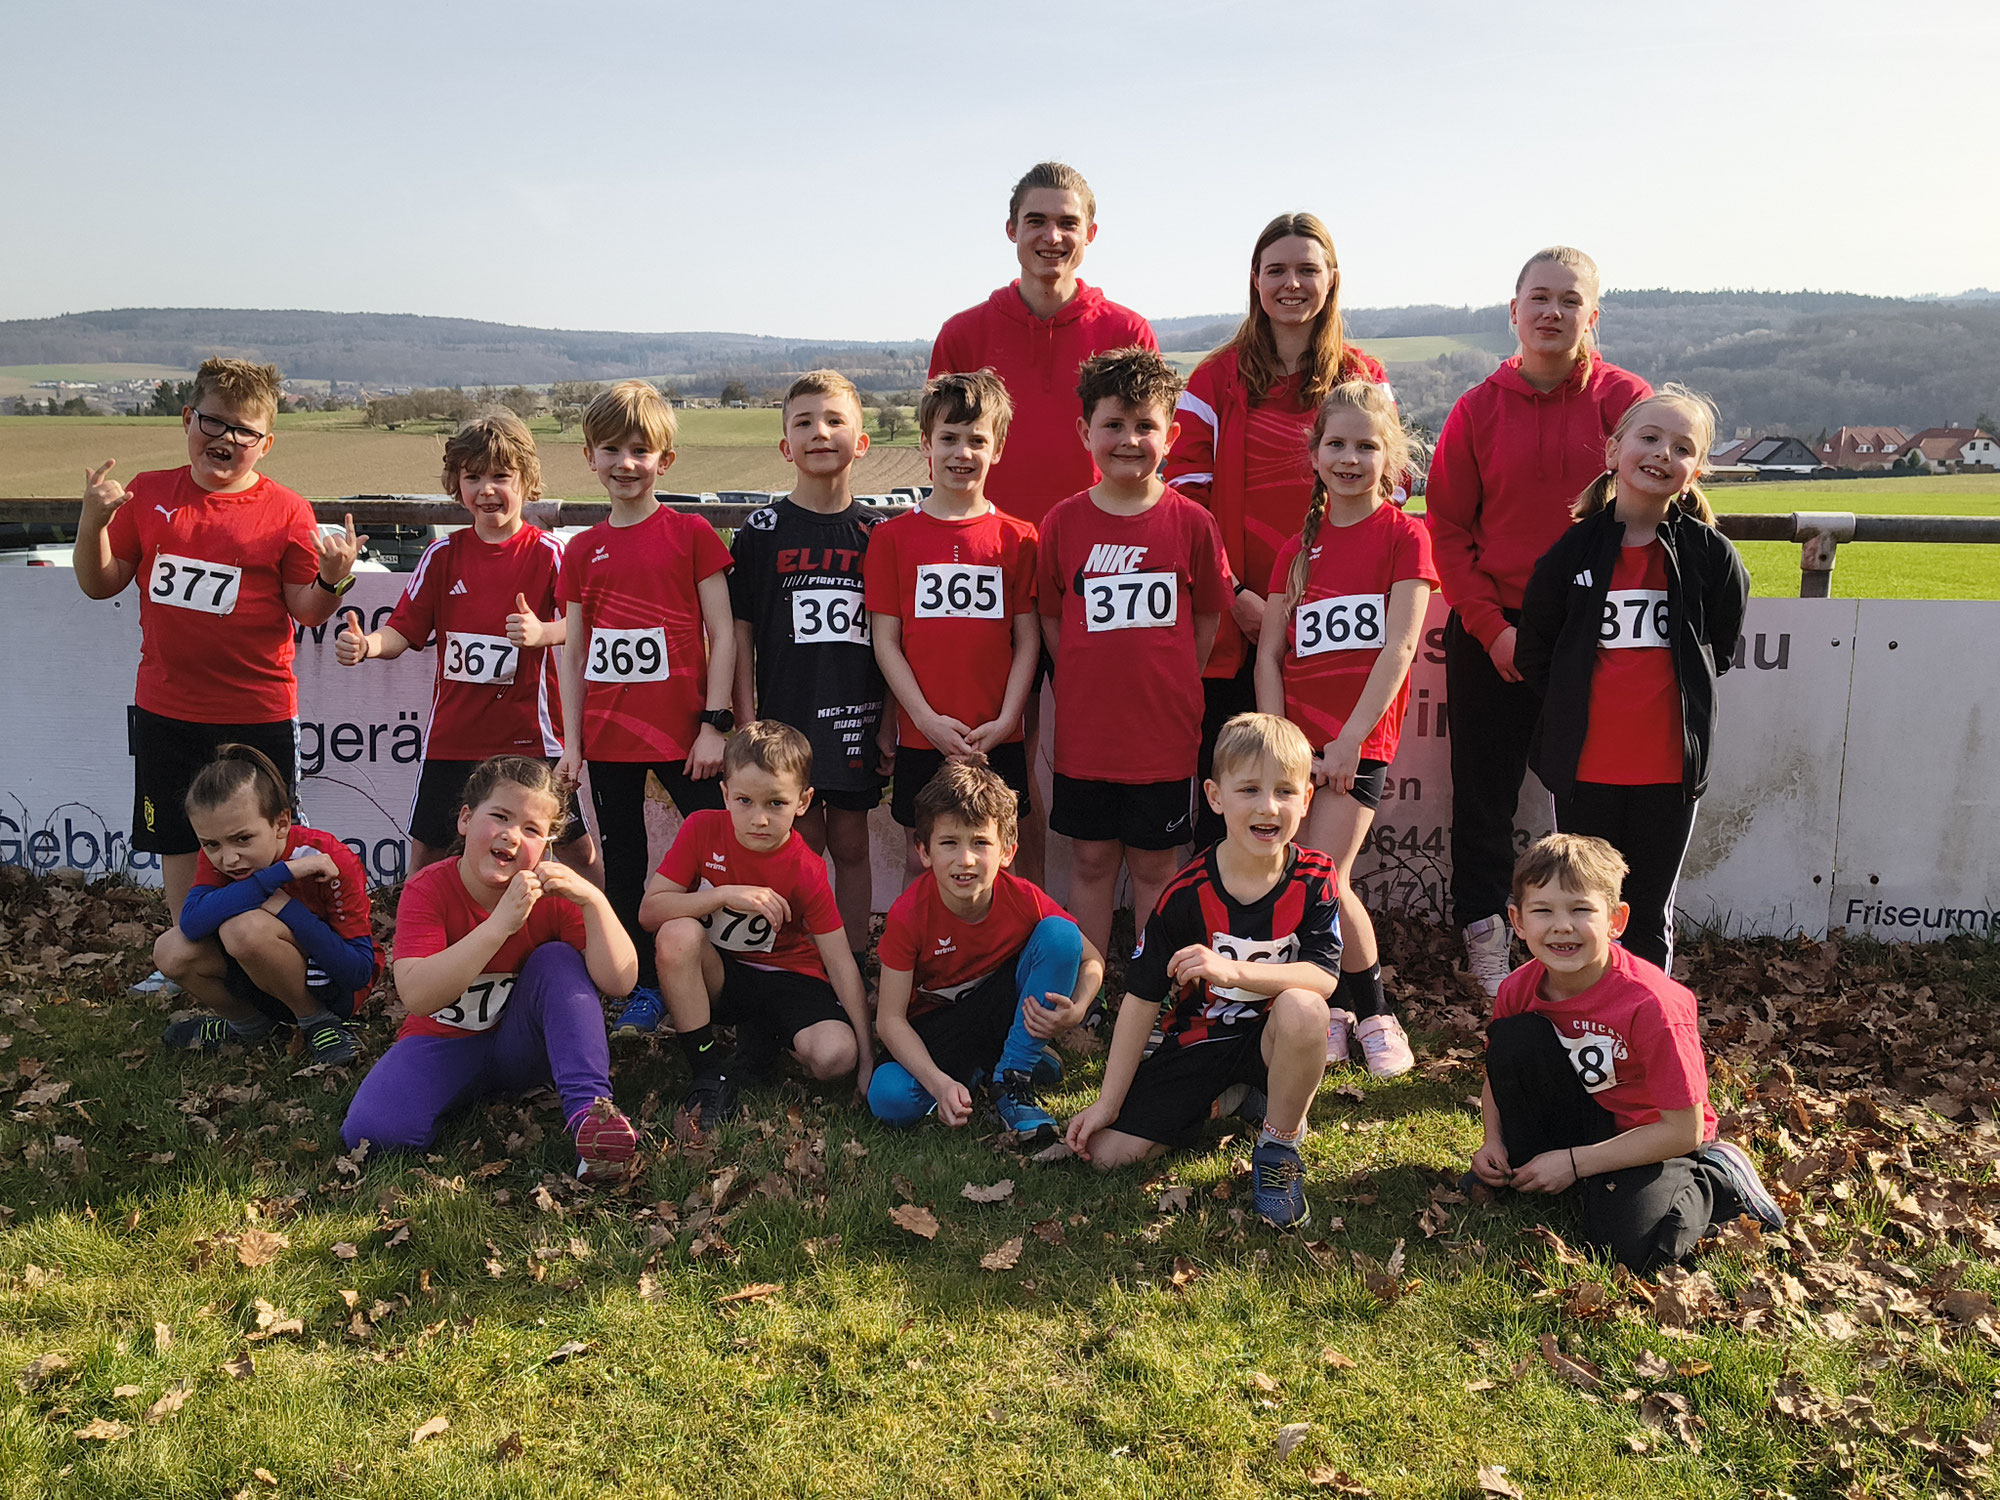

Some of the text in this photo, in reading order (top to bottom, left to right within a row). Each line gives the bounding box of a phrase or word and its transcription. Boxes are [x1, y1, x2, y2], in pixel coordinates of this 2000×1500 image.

[1083, 543, 1149, 573] NIKE
[152, 562, 234, 606] 377
[920, 573, 997, 611] 365
[1091, 581, 1172, 623] 370
[799, 598, 868, 637] 364
[1301, 603, 1380, 648] 368
[448, 640, 513, 678] 367
[592, 637, 661, 675] 369
